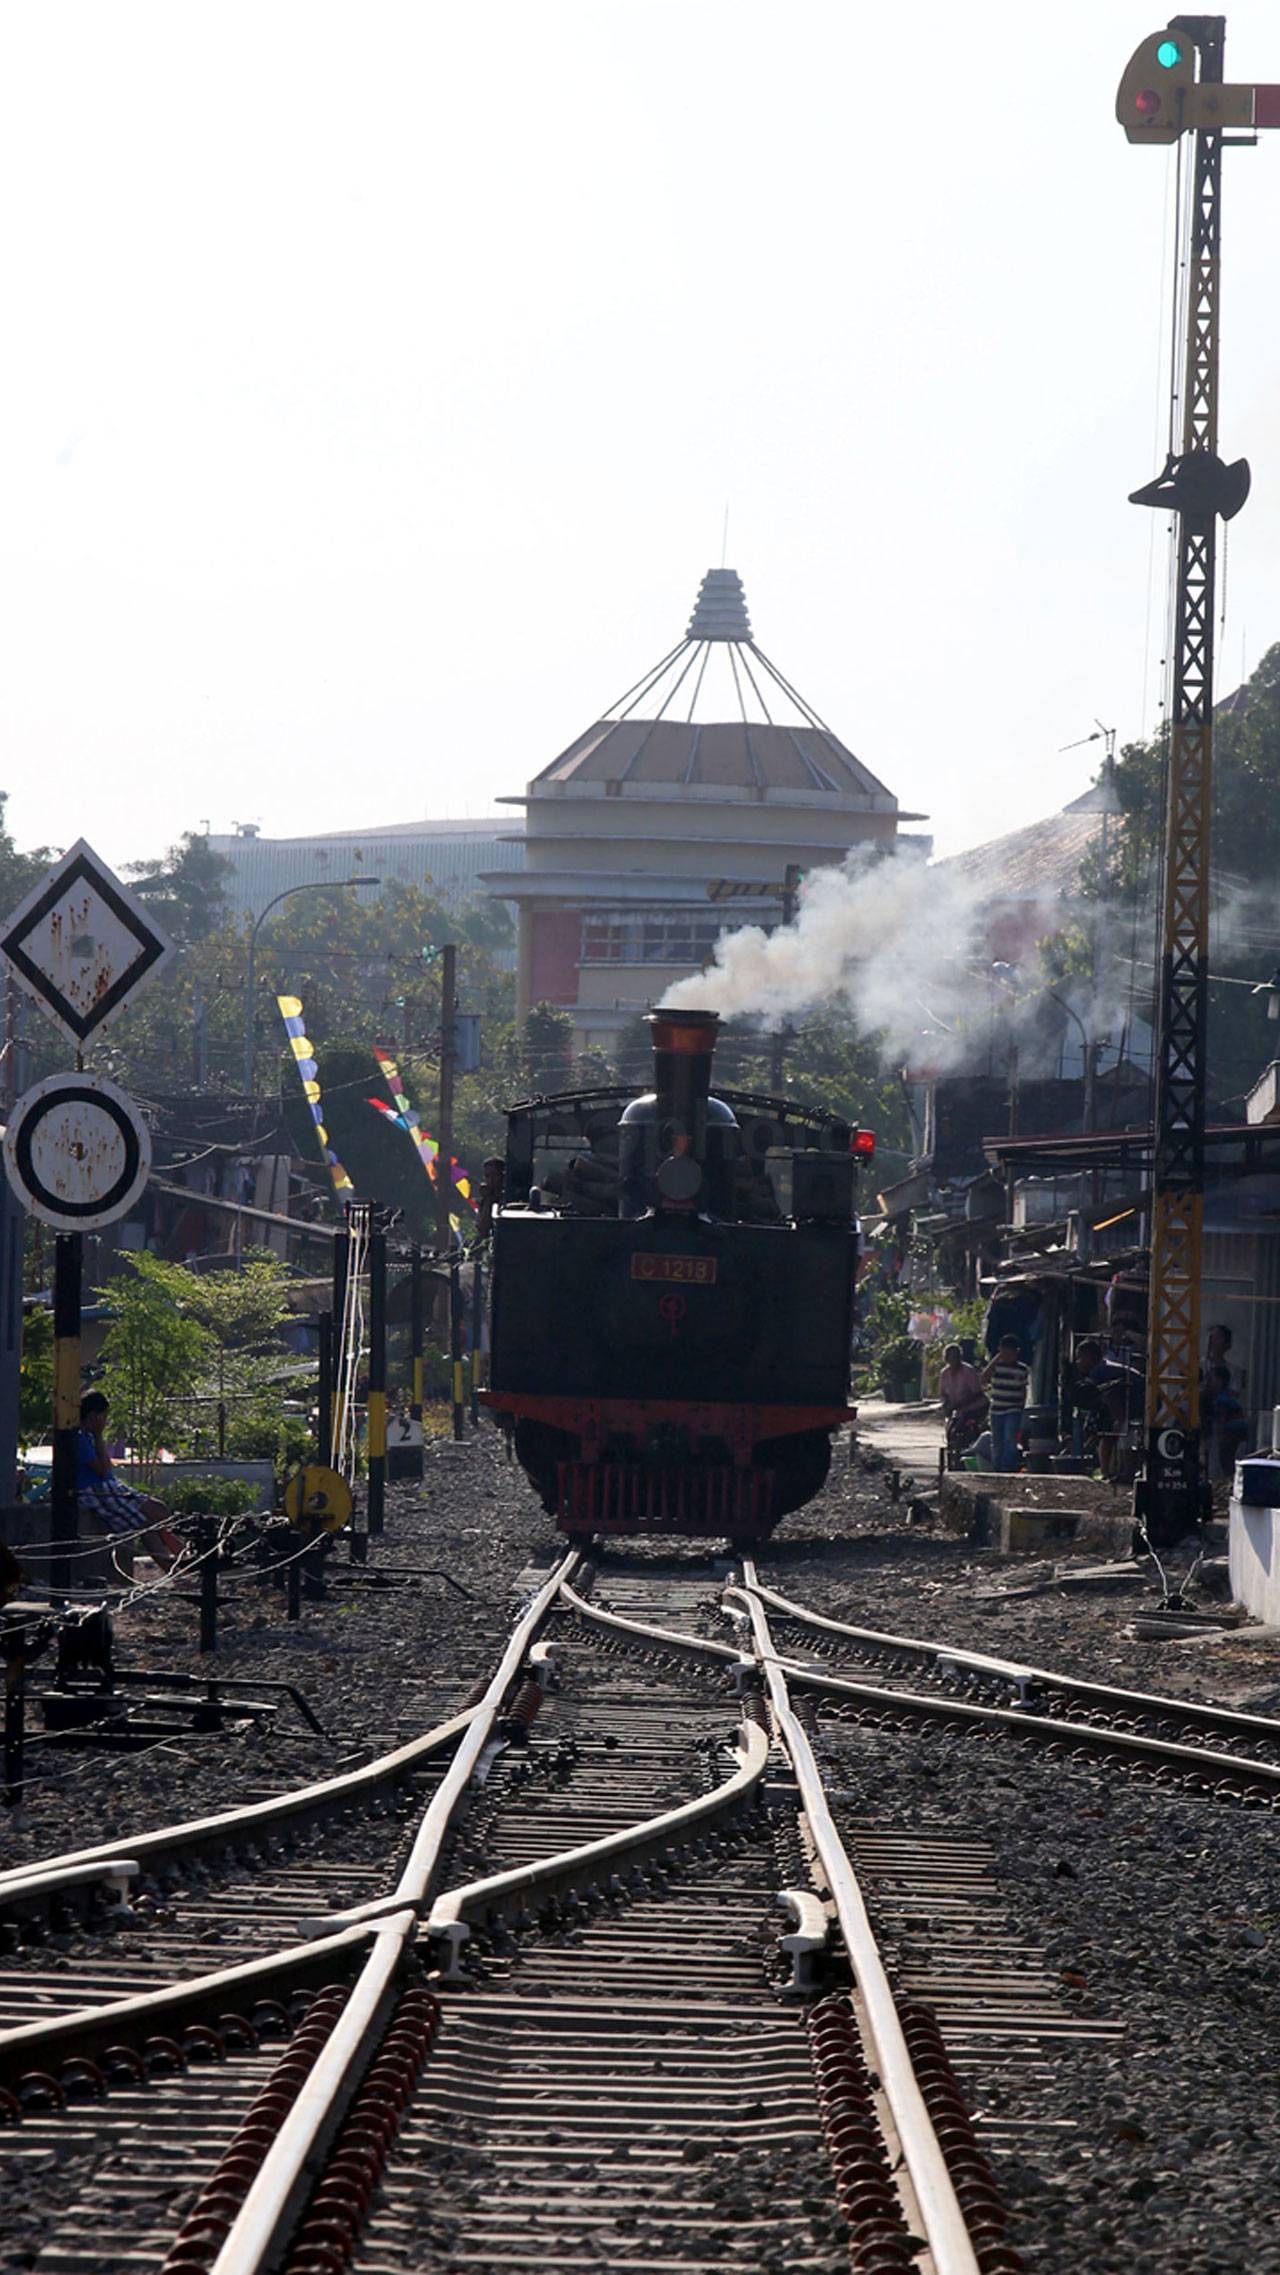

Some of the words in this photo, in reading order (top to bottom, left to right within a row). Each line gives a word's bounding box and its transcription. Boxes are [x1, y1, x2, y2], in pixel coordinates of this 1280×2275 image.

[639, 1257, 656, 1277] C
[662, 1259, 708, 1280] 1218
[399, 1418, 412, 1441] 2
[1157, 1428, 1185, 1460] C
